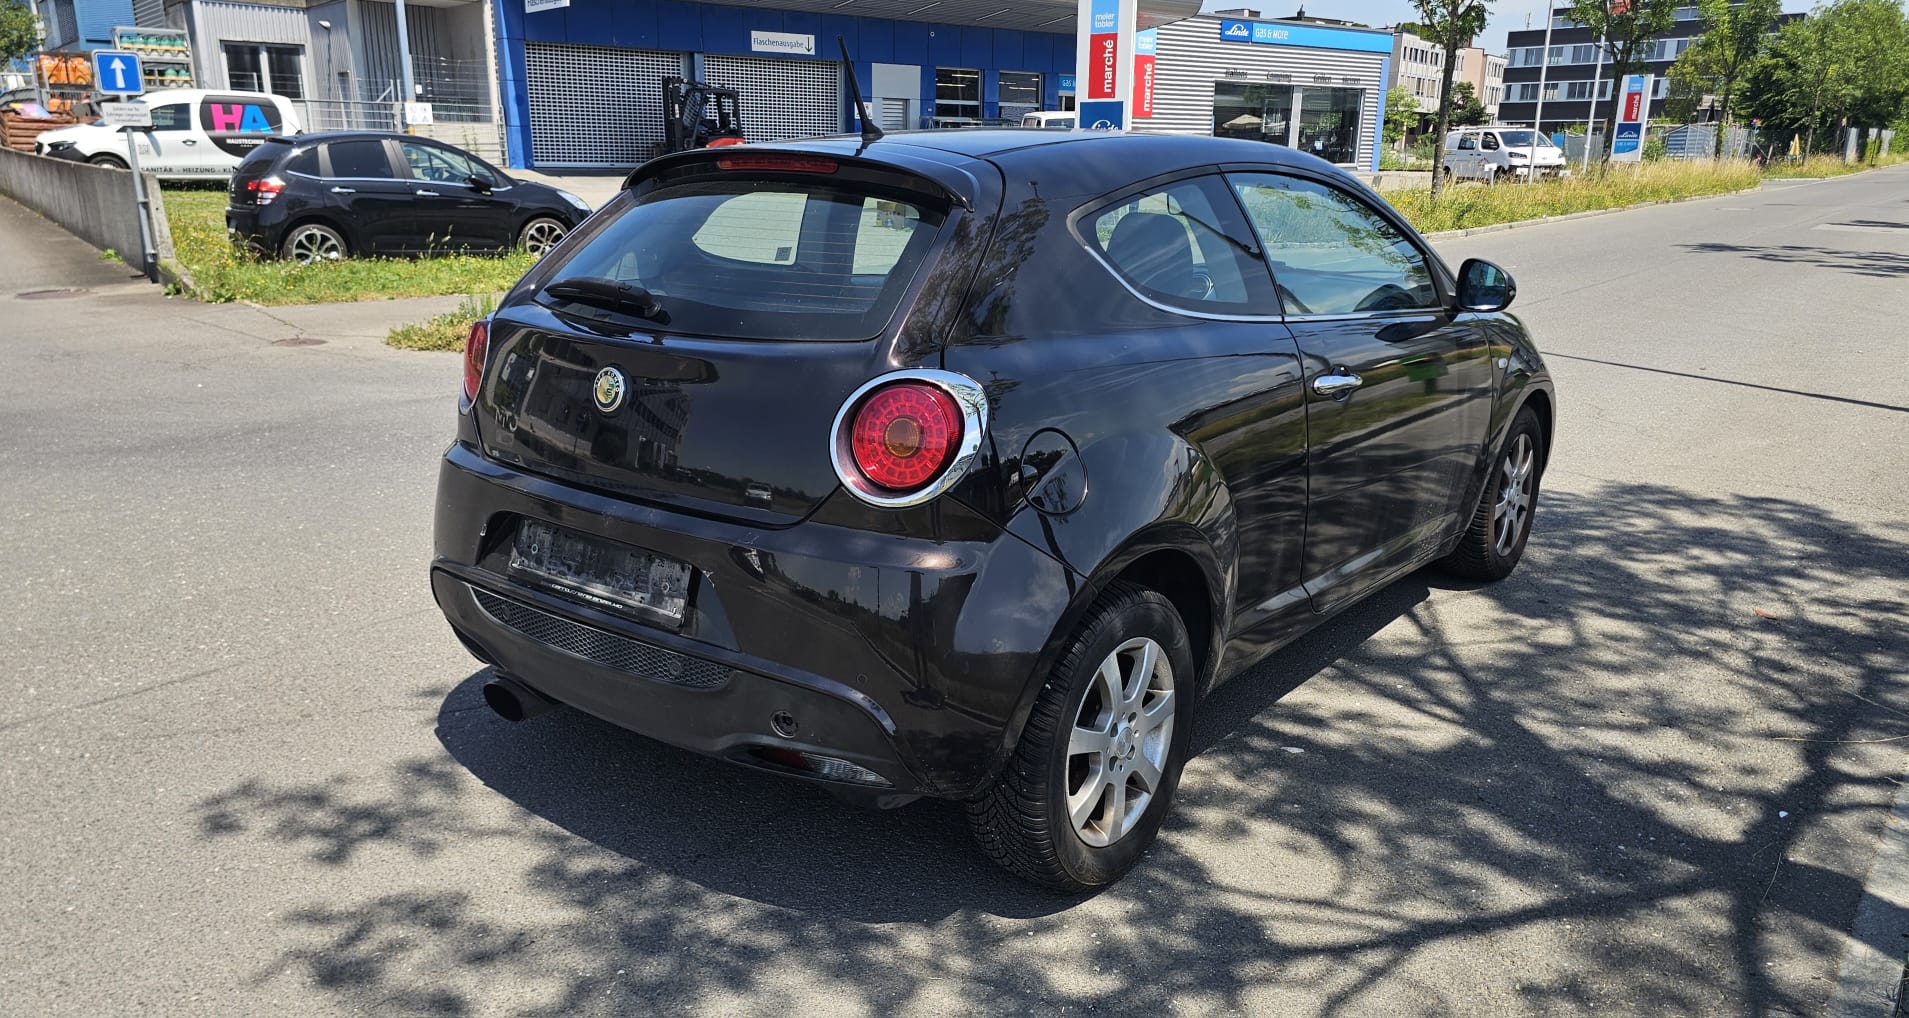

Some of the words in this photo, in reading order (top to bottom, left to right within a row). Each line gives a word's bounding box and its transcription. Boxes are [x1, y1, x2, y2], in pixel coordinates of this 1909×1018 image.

[1225, 23, 1249, 37] Linde
[753, 37, 804, 49] Flaschenausgabe
[1104, 39, 1114, 93] marché
[1144, 63, 1153, 112] marché
[210, 103, 273, 134] HA
[141, 165, 173, 173] SANITÄR
